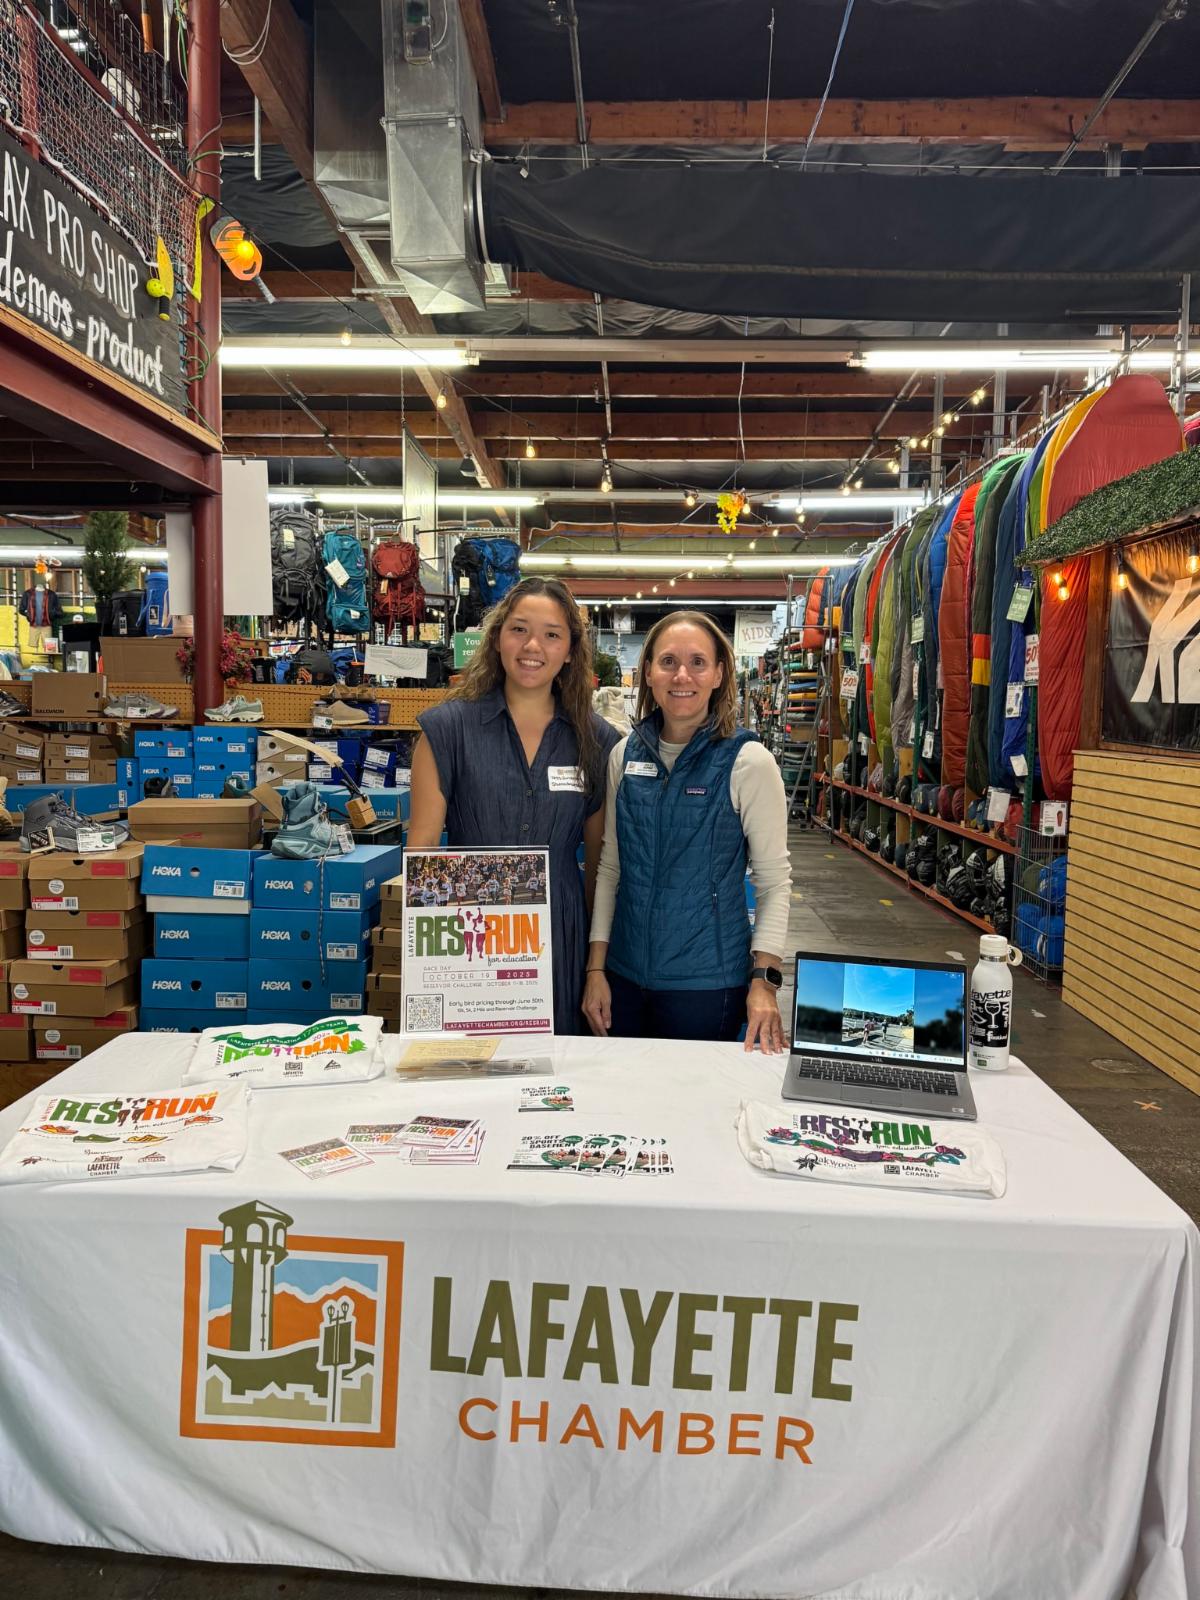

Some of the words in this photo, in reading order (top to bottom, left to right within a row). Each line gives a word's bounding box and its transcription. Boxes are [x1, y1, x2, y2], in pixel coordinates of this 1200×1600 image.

[0, 150, 35, 240] AX
[44, 189, 85, 278] PRO
[91, 231, 139, 319] SHOP
[152, 866, 181, 876] HOKA
[265, 880, 294, 890] HOKA
[160, 930, 189, 939] HOKA
[261, 930, 290, 940] HOKA
[416, 915, 465, 956] RES
[485, 913, 539, 955] RUN
[488, 956, 501, 966] for
[502, 955, 538, 963] education
[152, 980, 182, 990] HOKA
[261, 980, 291, 991] HOKA
[50, 1098, 123, 1124] RES
[143, 1095, 217, 1121] RUN
[800, 1114, 851, 1138] RES
[871, 1121, 934, 1146] RUN
[87, 1162, 120, 1171] LAFAYETTE
[430, 1276, 859, 1402] LAFAYETTE
[458, 1397, 815, 1464] CHAMBER
